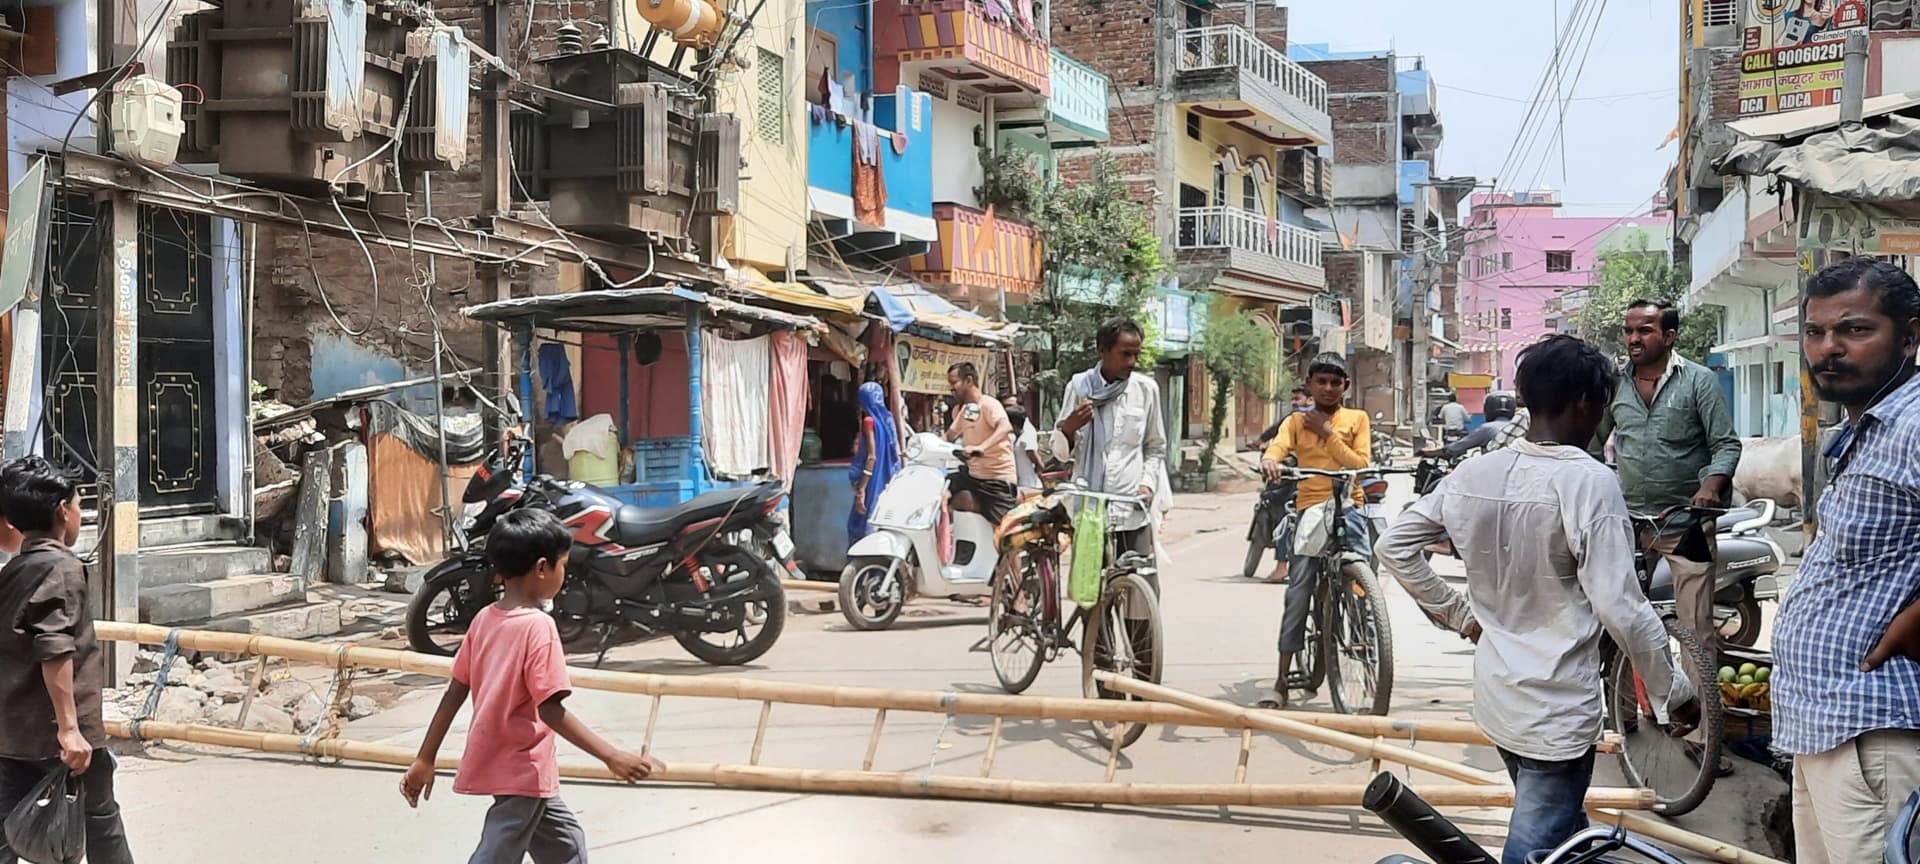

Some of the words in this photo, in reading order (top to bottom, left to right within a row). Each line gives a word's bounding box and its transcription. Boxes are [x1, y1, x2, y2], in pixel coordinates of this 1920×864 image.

[1842, 8, 1858, 21] JOB
[1744, 53, 1774, 71] CALL
[1740, 97, 1764, 113] DCA
[1779, 92, 1812, 109] ADCA
